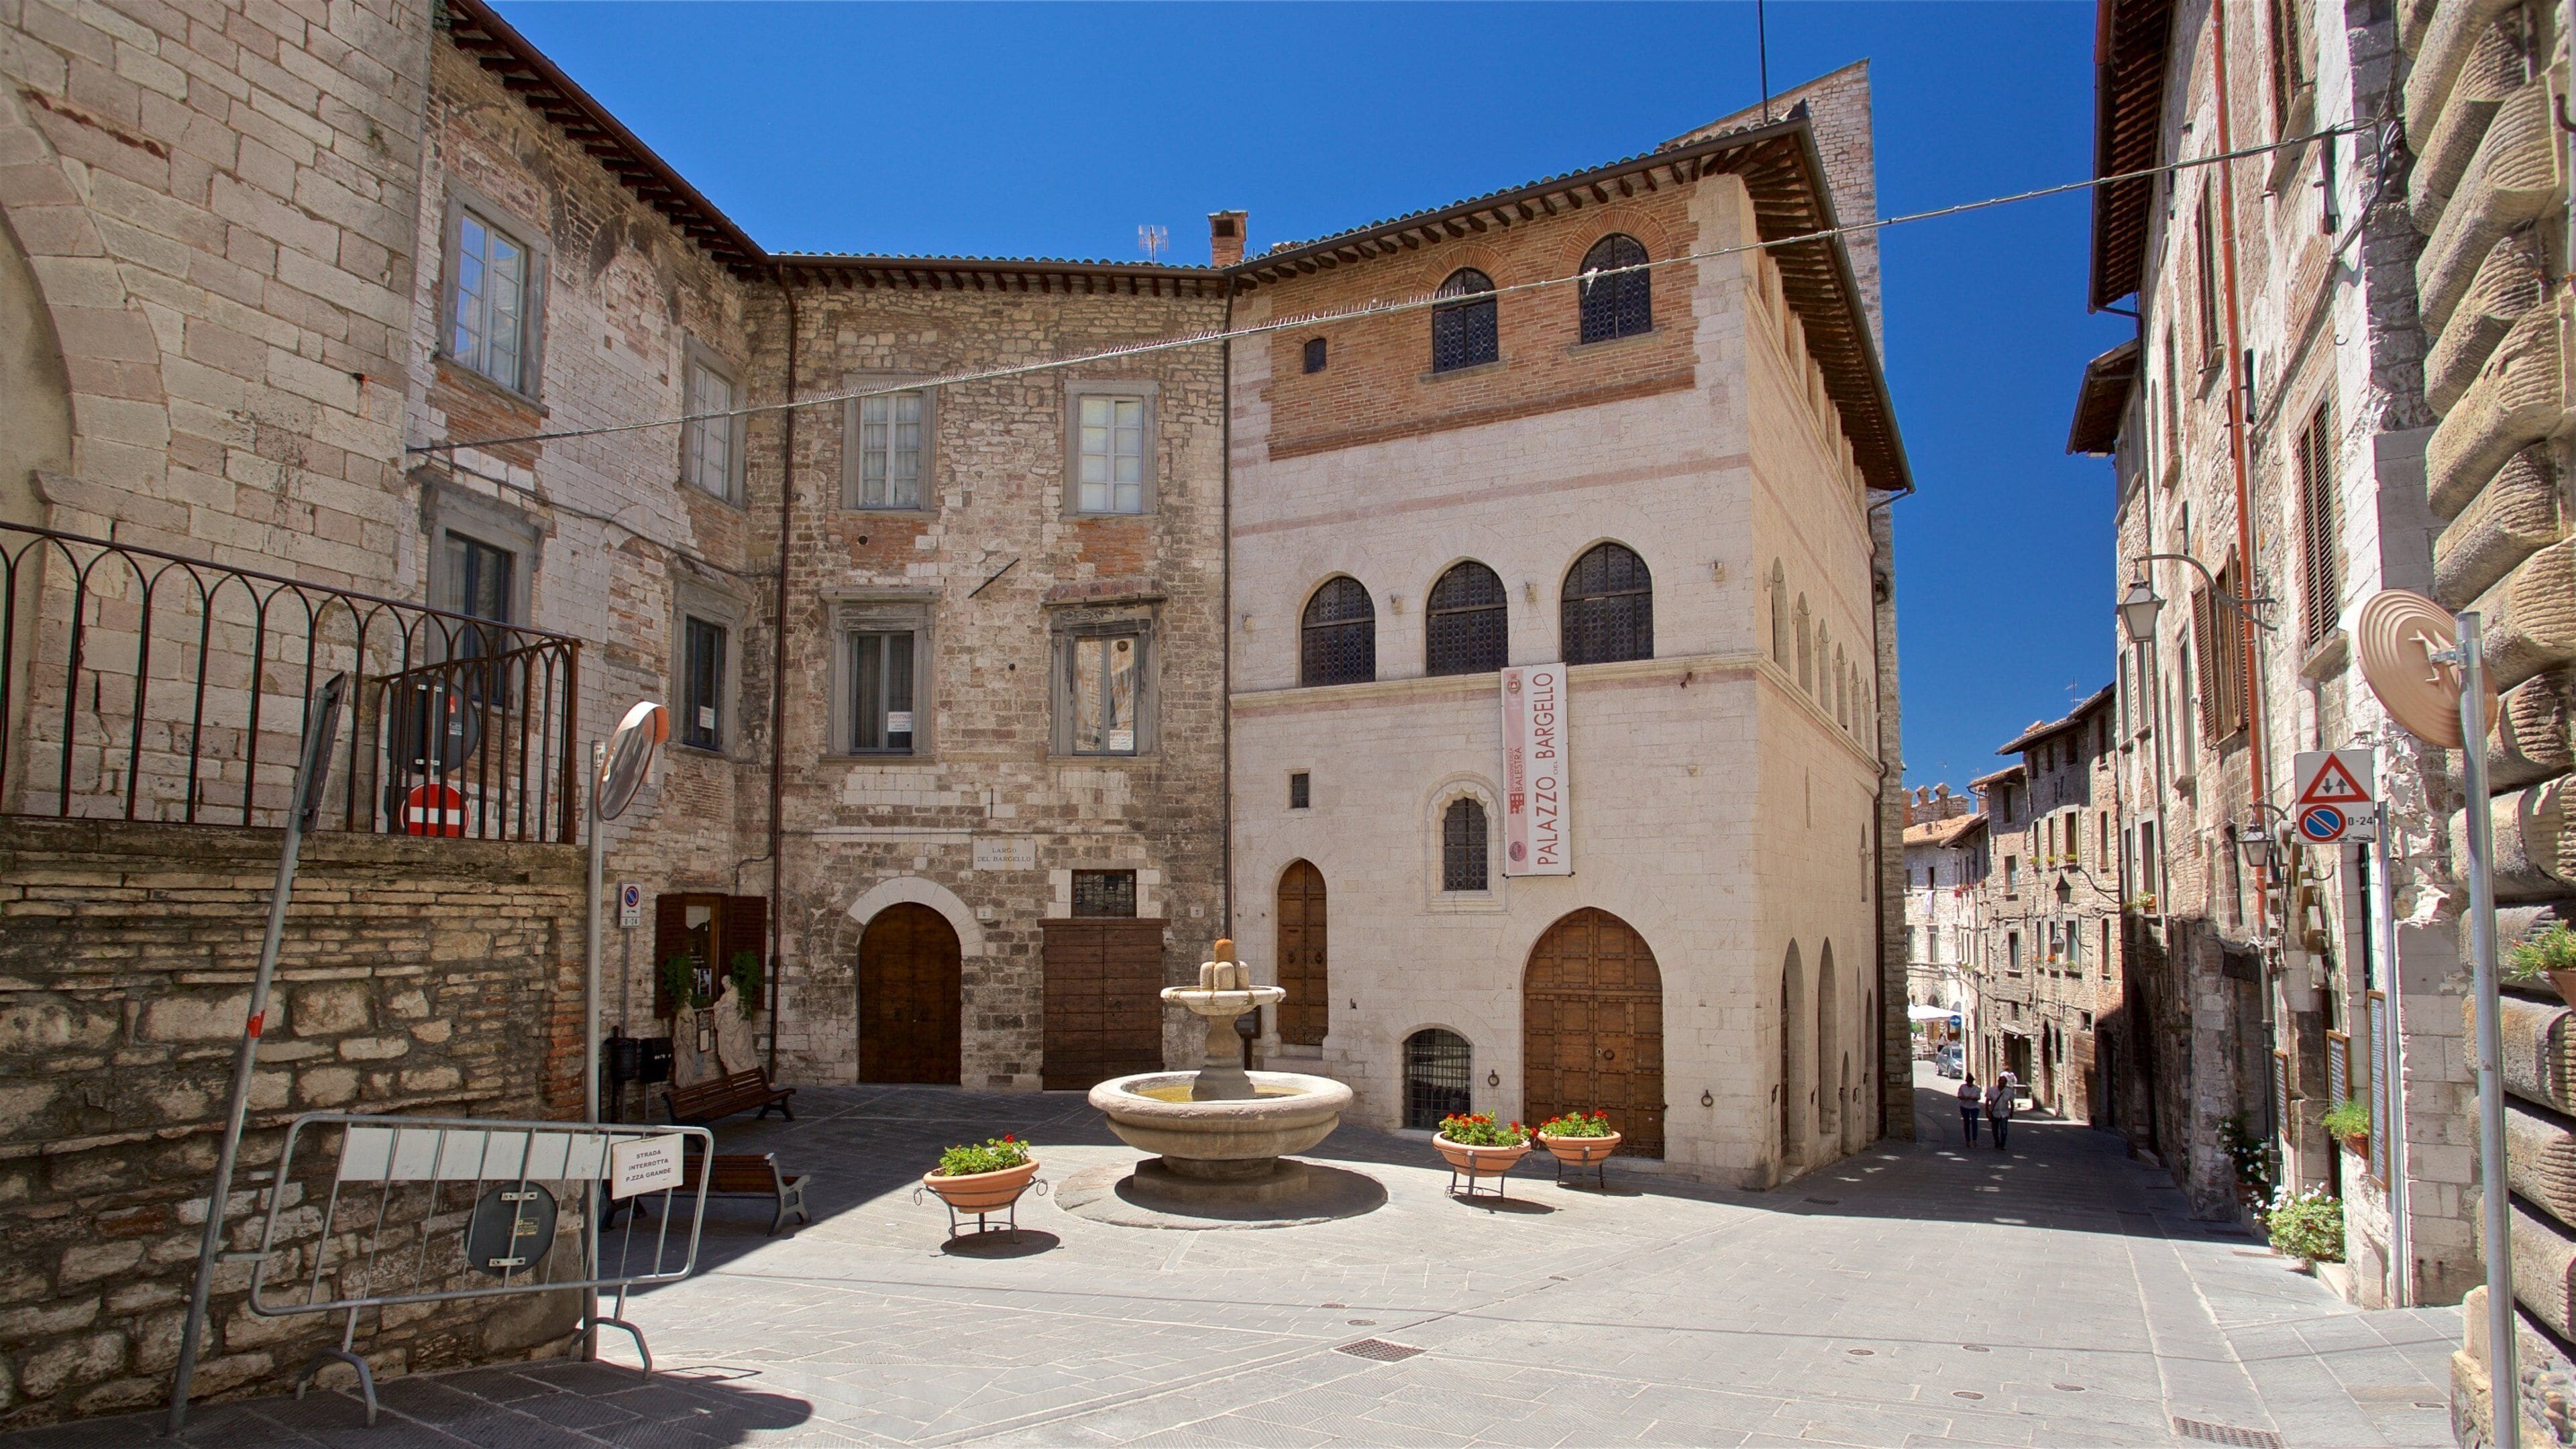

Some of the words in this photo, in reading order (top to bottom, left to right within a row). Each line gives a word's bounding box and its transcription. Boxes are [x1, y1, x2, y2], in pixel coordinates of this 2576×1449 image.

[1533, 673, 1555, 760] BARGELLO
[1514, 747, 1523, 792] BALESTRA
[1534, 777, 1558, 865] PALAZZO
[629, 1158, 669, 1171] INTERROTTA
[636, 1150, 661, 1159] STRADA
[626, 1174, 644, 1182] P.ZZA
[645, 1168, 671, 1177] GRANDE
